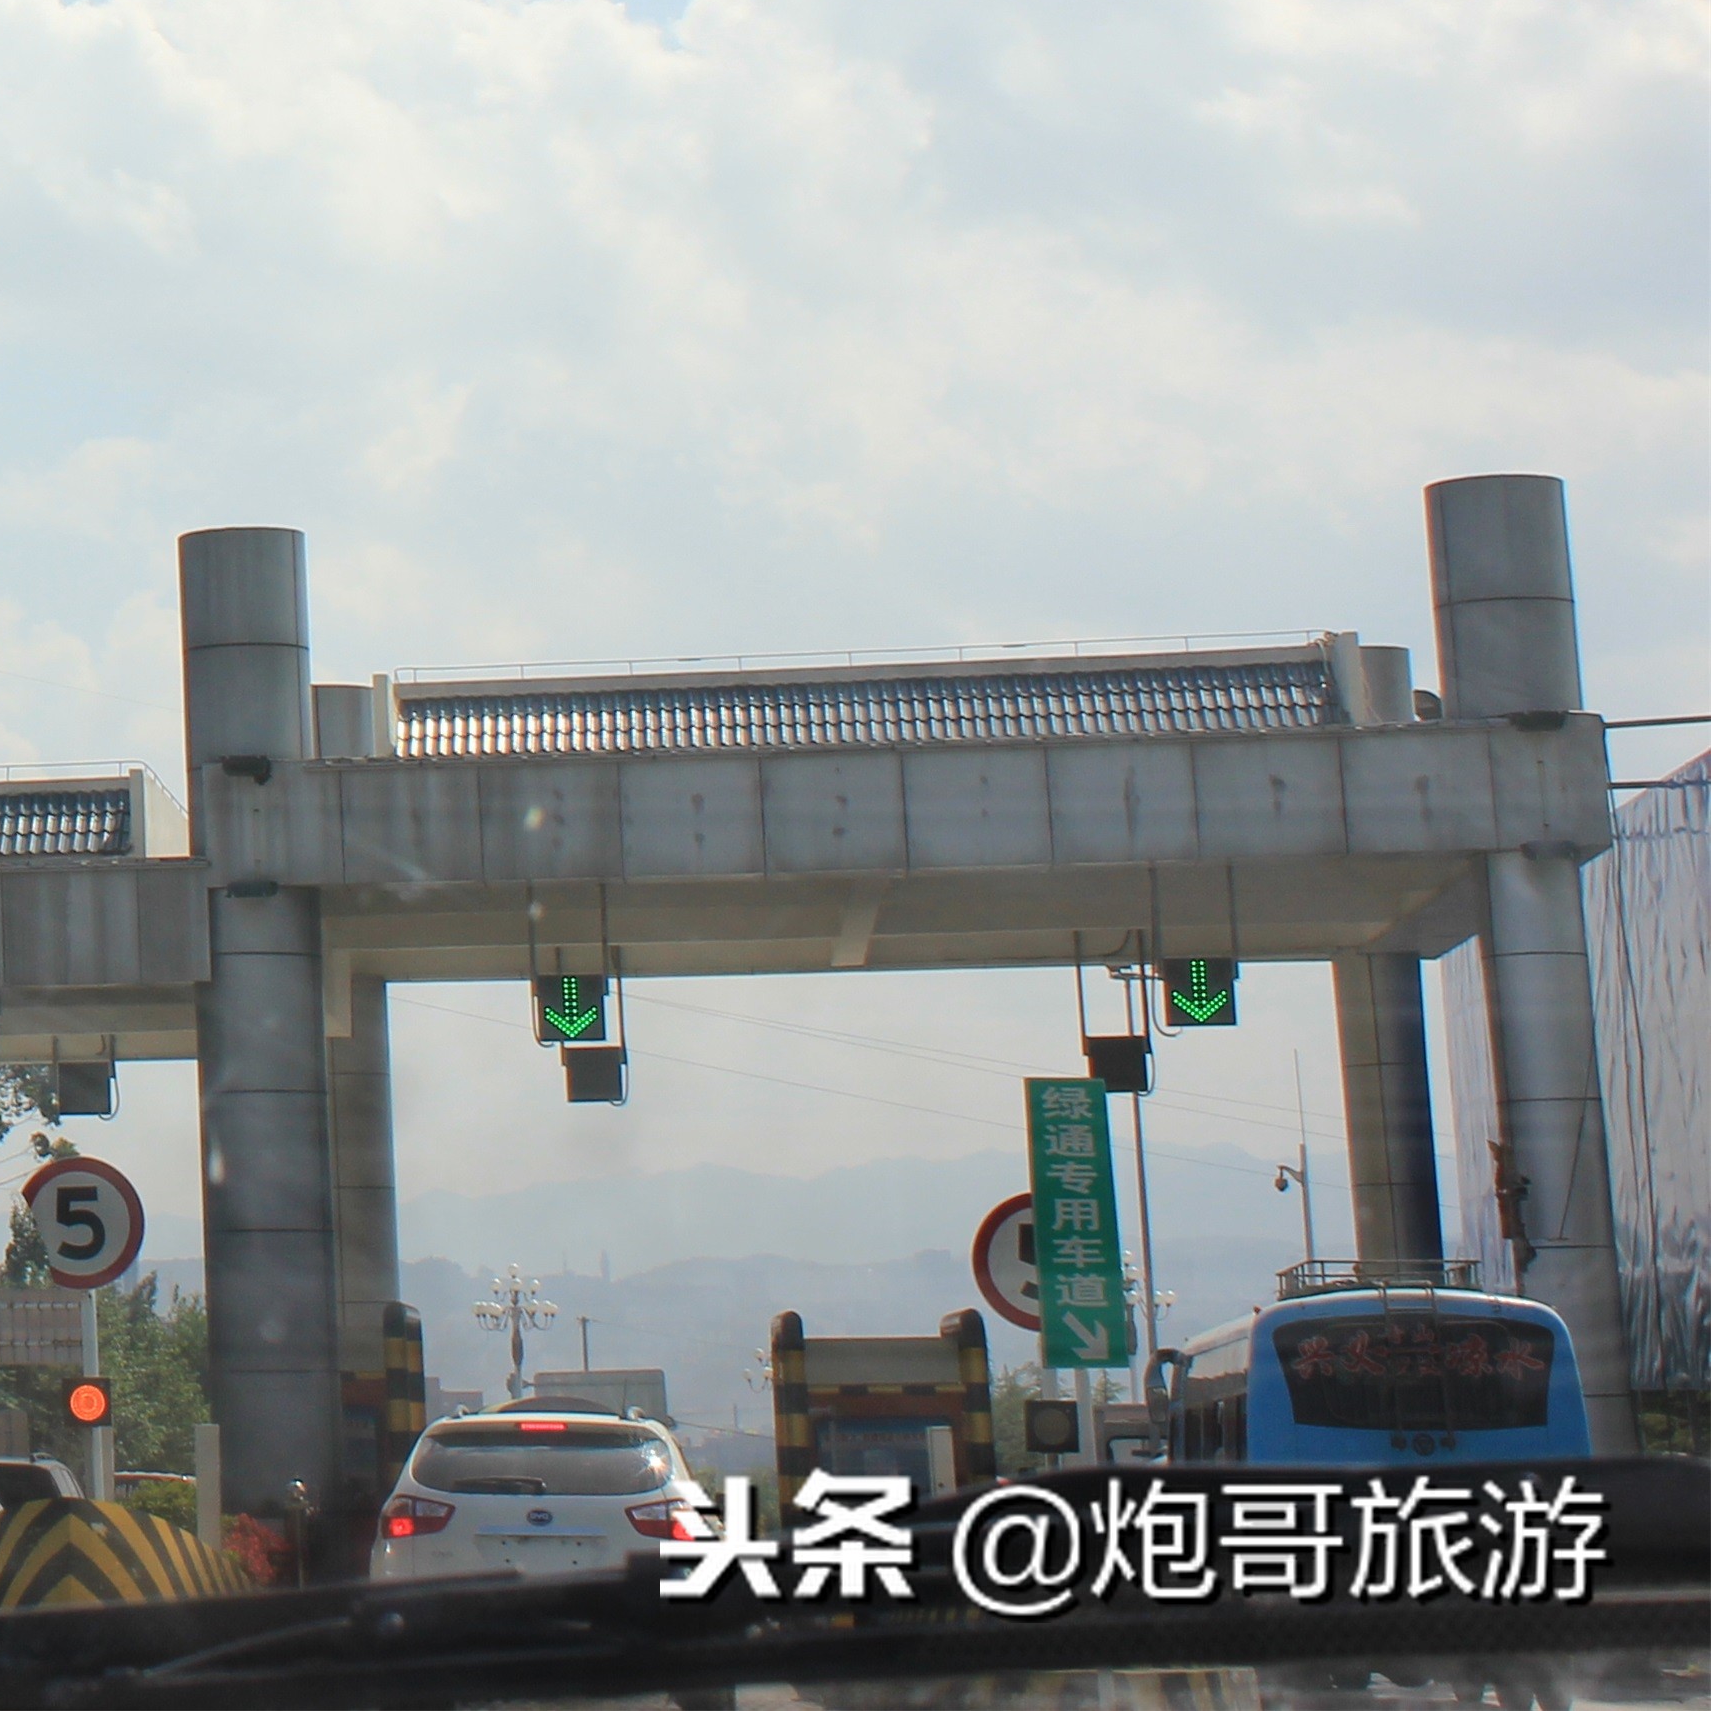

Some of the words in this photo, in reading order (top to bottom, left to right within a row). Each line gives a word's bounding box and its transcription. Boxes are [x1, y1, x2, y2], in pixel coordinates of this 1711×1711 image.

[56, 1186, 106, 1261] 5
[1041, 1085, 1109, 1308] 绿通专用车道
